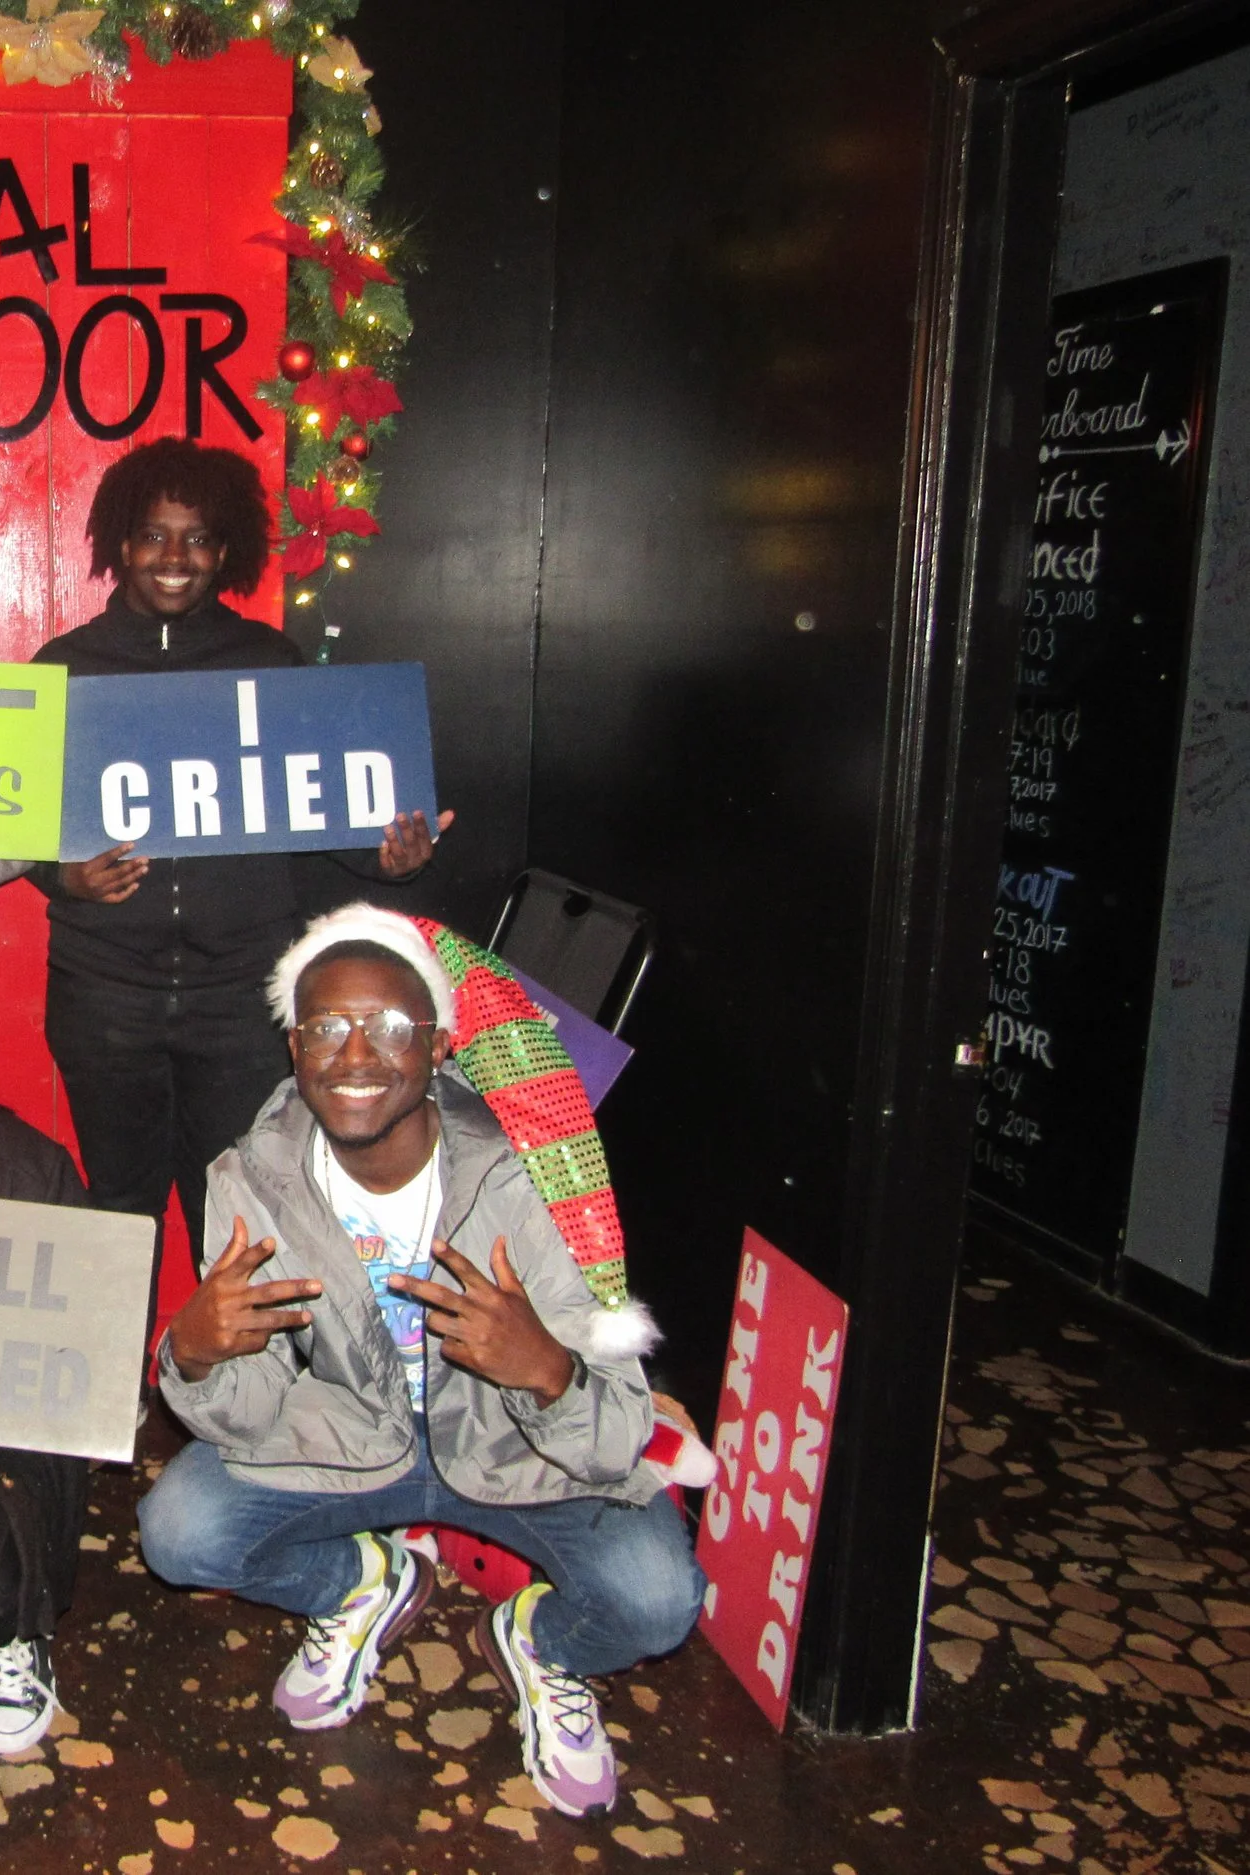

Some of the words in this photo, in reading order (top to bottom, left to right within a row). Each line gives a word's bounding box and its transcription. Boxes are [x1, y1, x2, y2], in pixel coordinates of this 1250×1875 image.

[237, 680, 259, 746] I
[100, 751, 396, 842] CRIED
[706, 1251, 769, 1543] CAME
[742, 1409, 781, 1533] TO
[757, 1326, 840, 1699] DRINK
